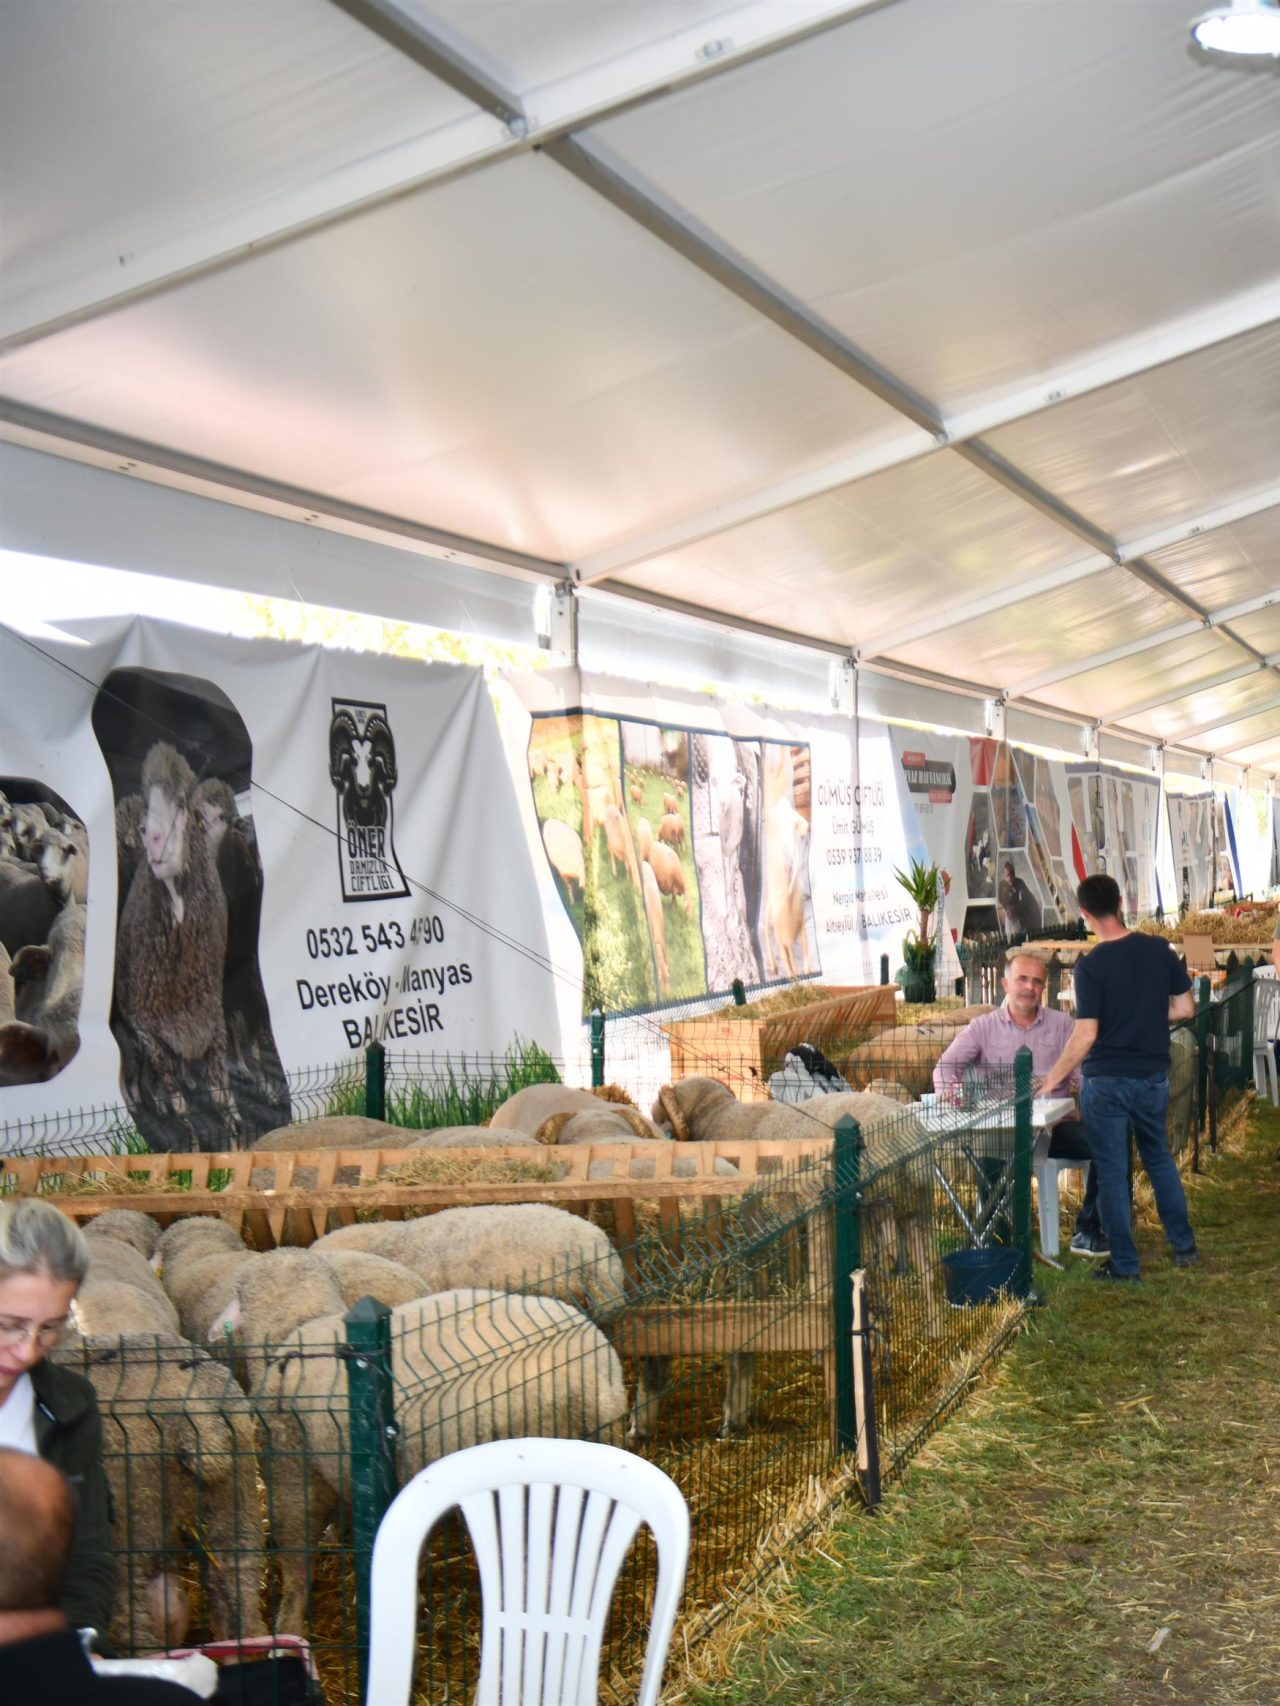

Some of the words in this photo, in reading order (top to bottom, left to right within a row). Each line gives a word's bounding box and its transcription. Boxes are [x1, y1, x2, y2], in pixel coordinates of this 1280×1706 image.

[306, 928, 358, 960] 0532
[361, 921, 405, 953] 543
[296, 970, 391, 1010] Dereköy
